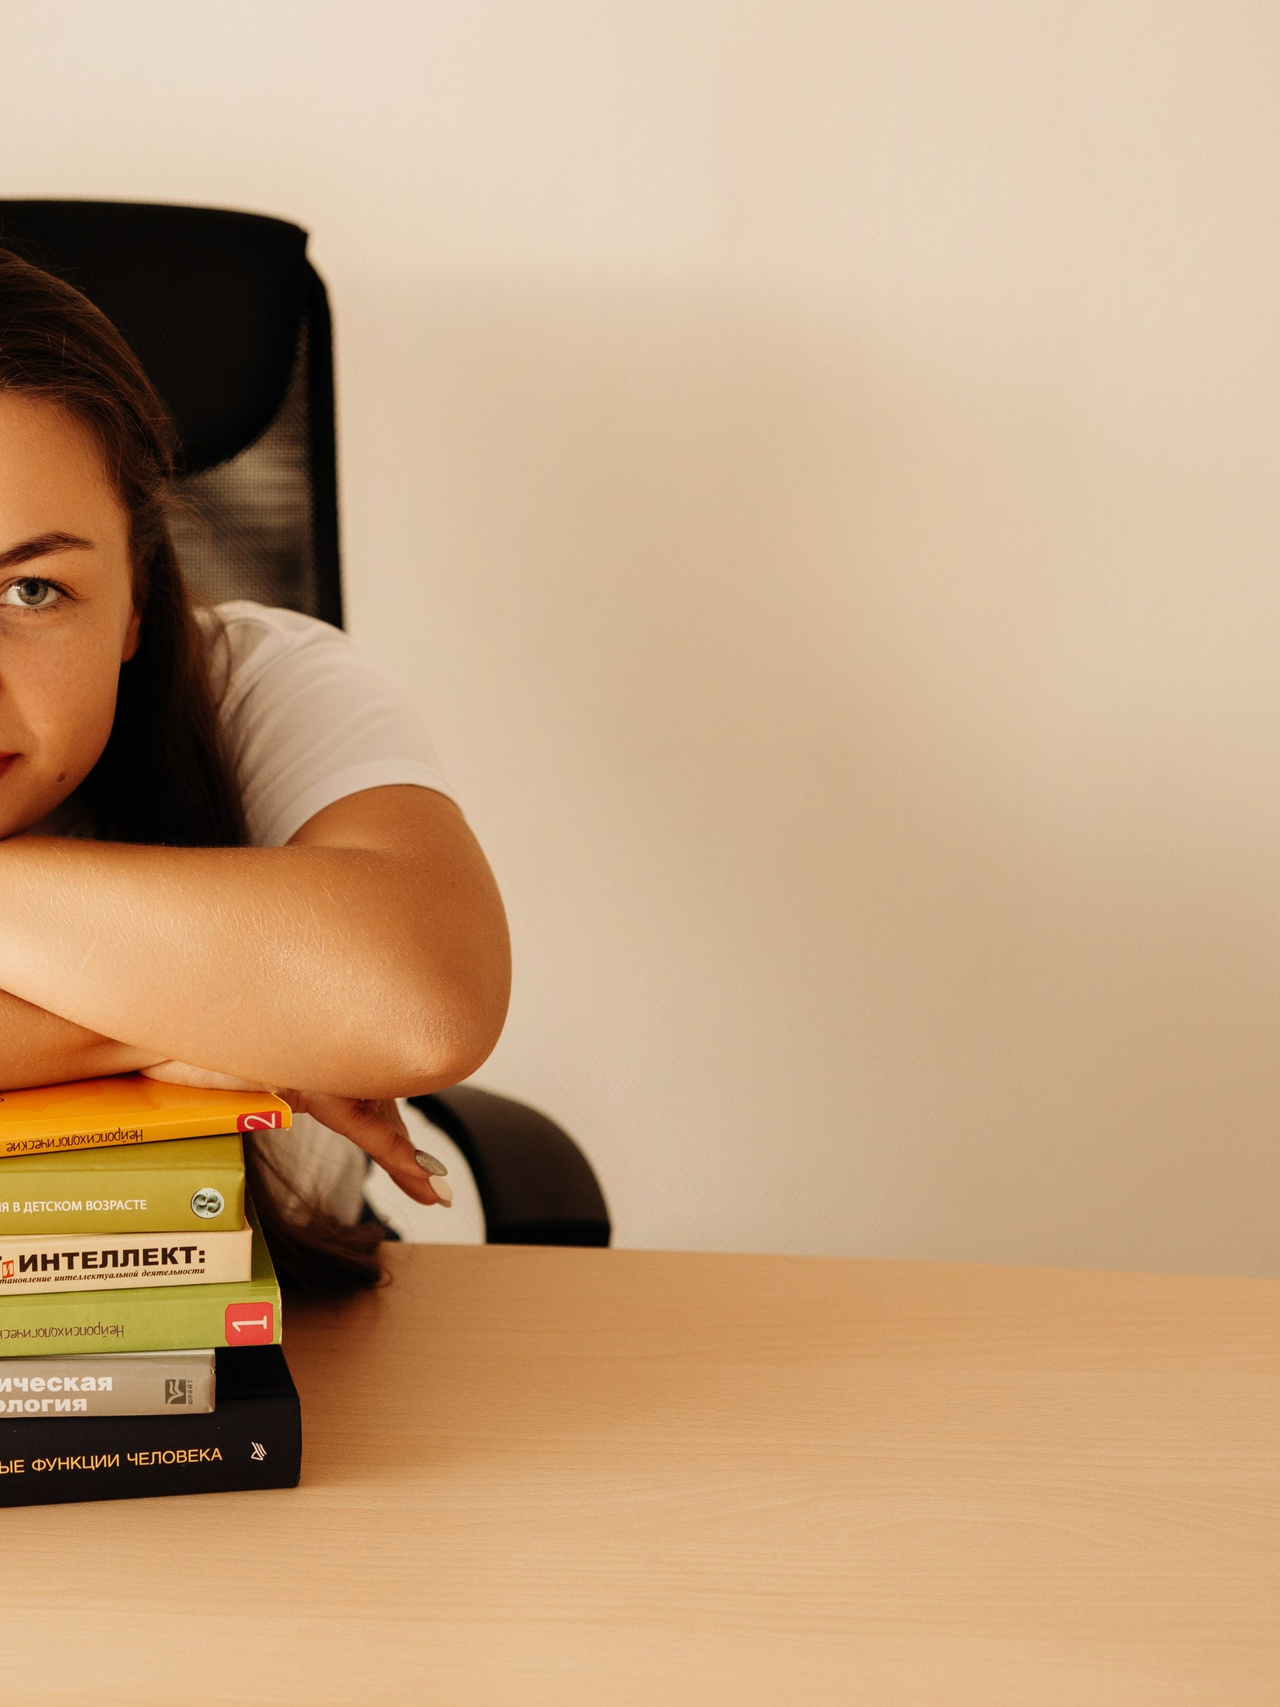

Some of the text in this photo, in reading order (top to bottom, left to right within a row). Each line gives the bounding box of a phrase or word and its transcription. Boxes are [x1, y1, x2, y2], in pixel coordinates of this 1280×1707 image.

[244, 1113, 276, 1129] 2
[6, 1128, 143, 1152] Нейропсихологические
[13, 1201, 21, 1212] В
[23, 1200, 82, 1214] ДЕТСКОМ
[86, 1199, 147, 1211] ВОЗРАСТЕ
[19, 1246, 205, 1272] ИНТЕЛЛЕКТ:
[54, 1270, 138, 1282] интеллектуальной
[141, 1267, 205, 1278] деятельности
[232, 1315, 267, 1332] 1
[32, 1454, 119, 1473] ФУНКЦИИ
[127, 1448, 222, 1466] ЧЕЛОВЕКА
